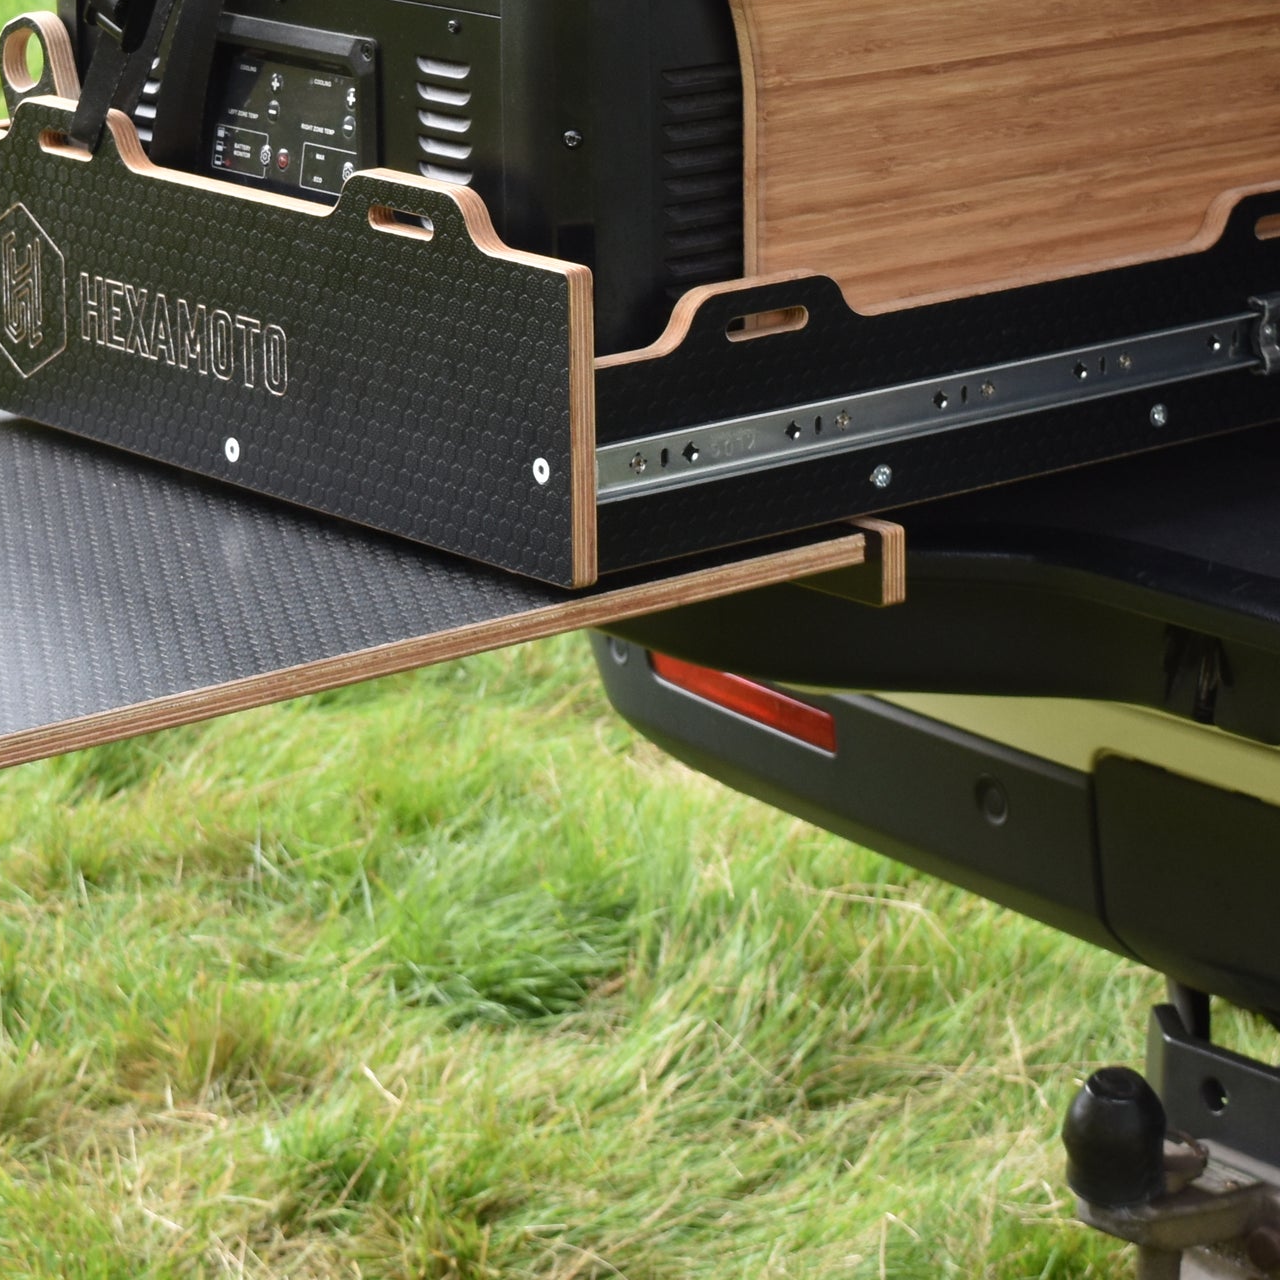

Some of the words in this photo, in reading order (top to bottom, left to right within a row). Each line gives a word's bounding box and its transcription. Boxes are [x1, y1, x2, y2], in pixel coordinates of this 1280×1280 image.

[314, 79, 331, 87] COOLING
[228, 109, 237, 117] LEFT
[238, 110, 248, 118] ZONE
[248, 111, 258, 119] TEMP
[301, 123, 313, 131] RIGHT
[313, 125, 323, 133] ZONE
[324, 127, 335, 135] TEMP
[234, 143, 251, 151] BATTERY
[80, 272, 288, 396] HEXAMOTO
